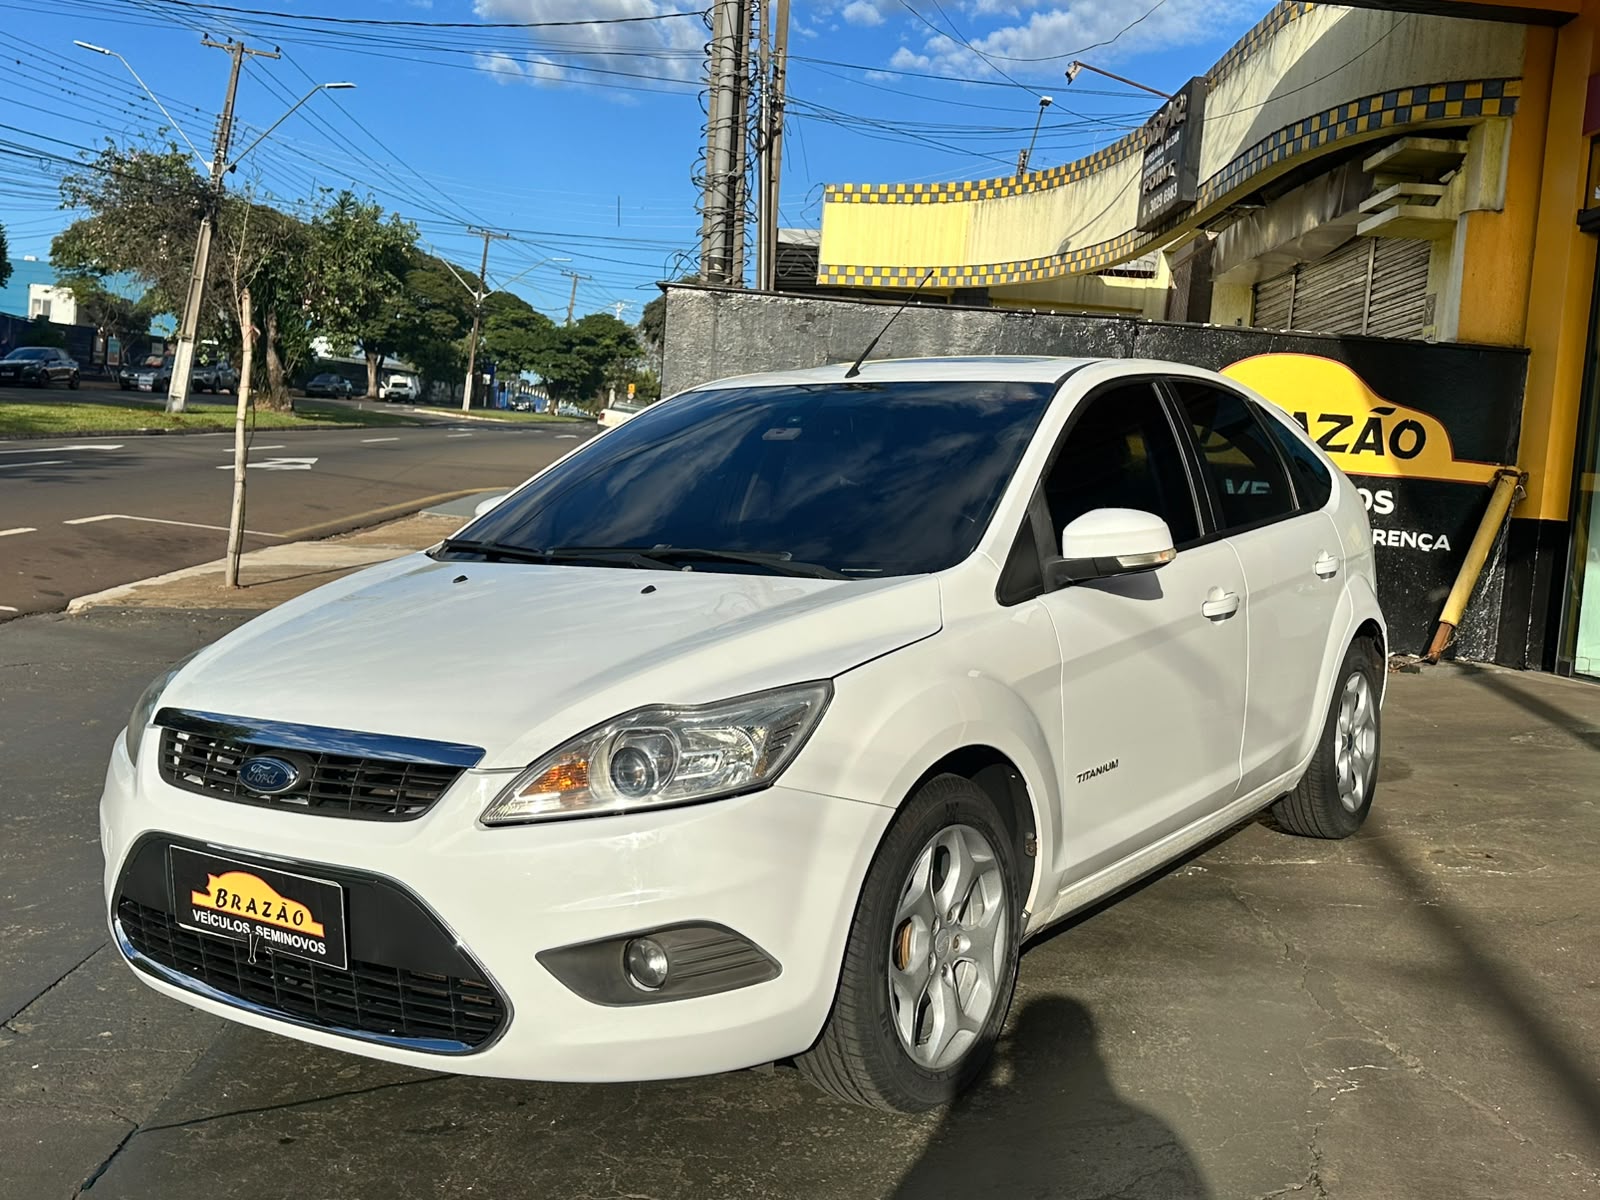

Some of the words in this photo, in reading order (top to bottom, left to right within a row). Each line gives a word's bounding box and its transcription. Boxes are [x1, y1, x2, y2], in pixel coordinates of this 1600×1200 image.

[1371, 528, 1451, 552] RENÇA
[247, 763, 279, 784] Ford
[1076, 758, 1119, 784] TITANIUM
[215, 888, 304, 926] BRAZÃO
[192, 909, 251, 934] VEÍCULOS
[255, 925, 327, 955] SEMINOVOS
